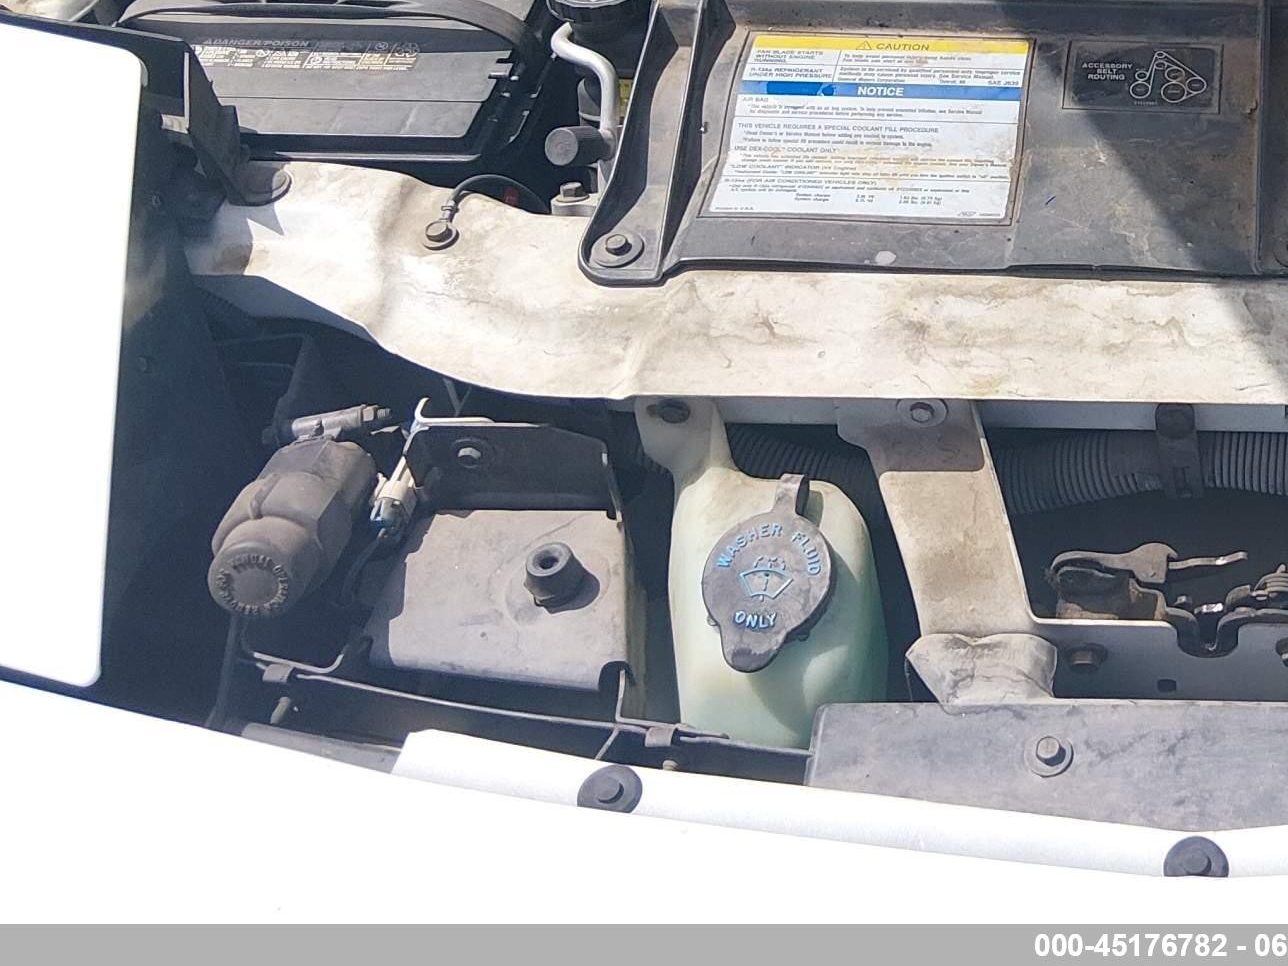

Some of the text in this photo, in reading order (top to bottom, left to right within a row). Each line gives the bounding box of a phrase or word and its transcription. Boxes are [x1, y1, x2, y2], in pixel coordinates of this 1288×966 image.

[876, 43, 930, 51] CAUTION
[1087, 73, 1125, 81] ROUTING
[856, 86, 904, 97] NOTICE
[716, 522, 823, 577] WASHER FLUID
[734, 610, 777, 629] ONLY
